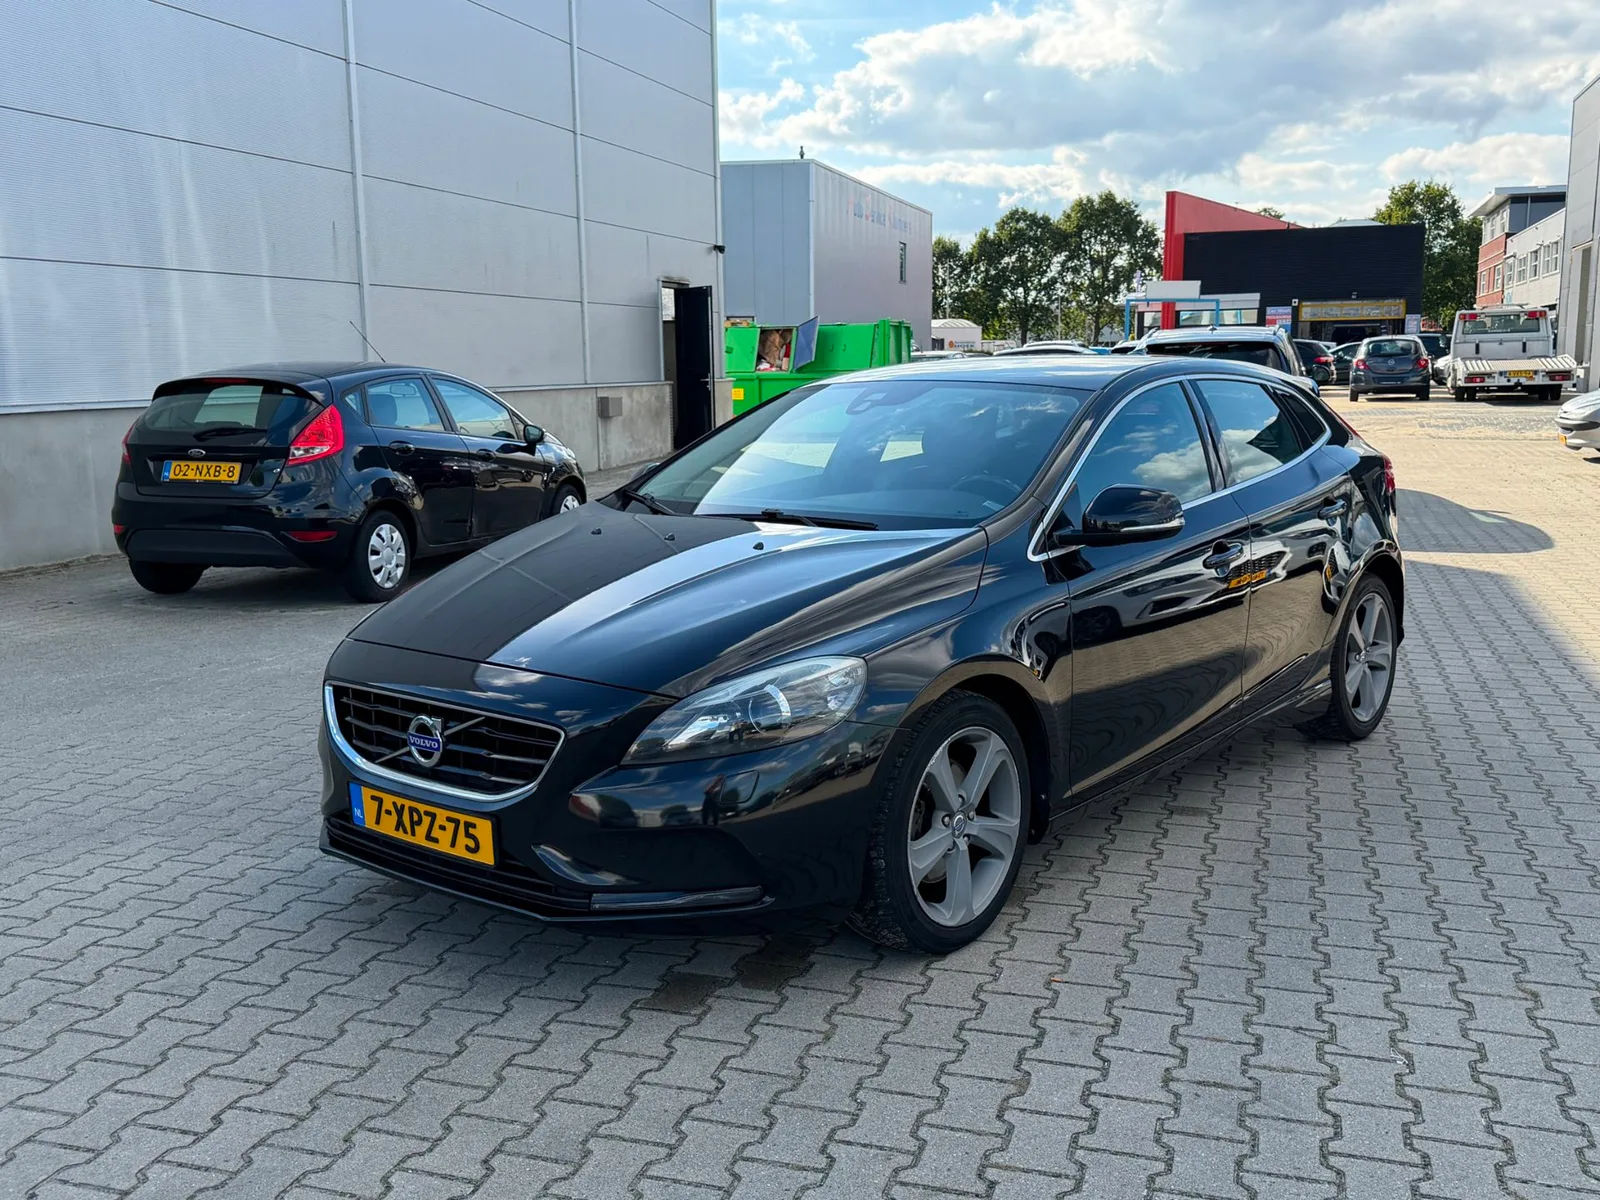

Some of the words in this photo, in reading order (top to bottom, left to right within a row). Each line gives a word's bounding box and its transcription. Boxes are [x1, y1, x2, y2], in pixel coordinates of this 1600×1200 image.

[173, 463, 236, 478] 02-NXB-8
[409, 735, 438, 749] VOLVO
[354, 808, 363, 818] NL
[370, 795, 480, 853] 7-XPZ-75
